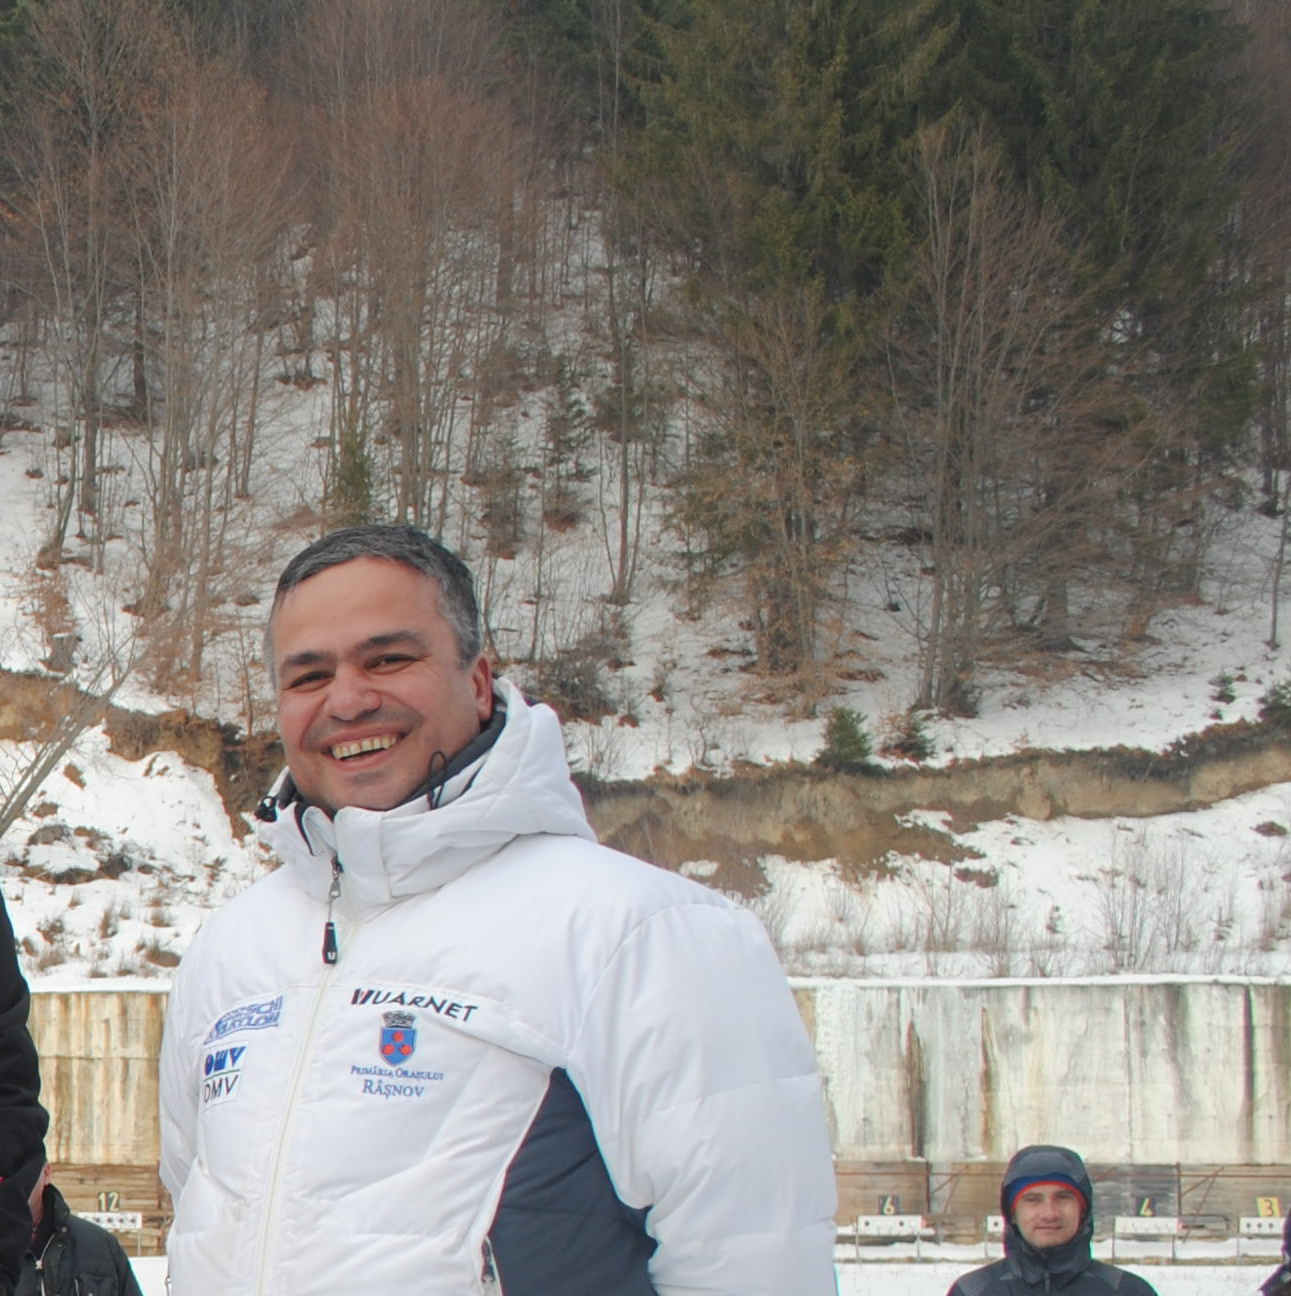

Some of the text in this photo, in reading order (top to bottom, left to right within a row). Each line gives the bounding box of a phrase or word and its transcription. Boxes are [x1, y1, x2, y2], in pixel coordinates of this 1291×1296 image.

[350, 987, 478, 1022] VUARNET
[204, 1045, 247, 1076] OMV
[98, 1191, 120, 1212] 12
[883, 1195, 895, 1216] 6
[1263, 1199, 1275, 1217] 3
